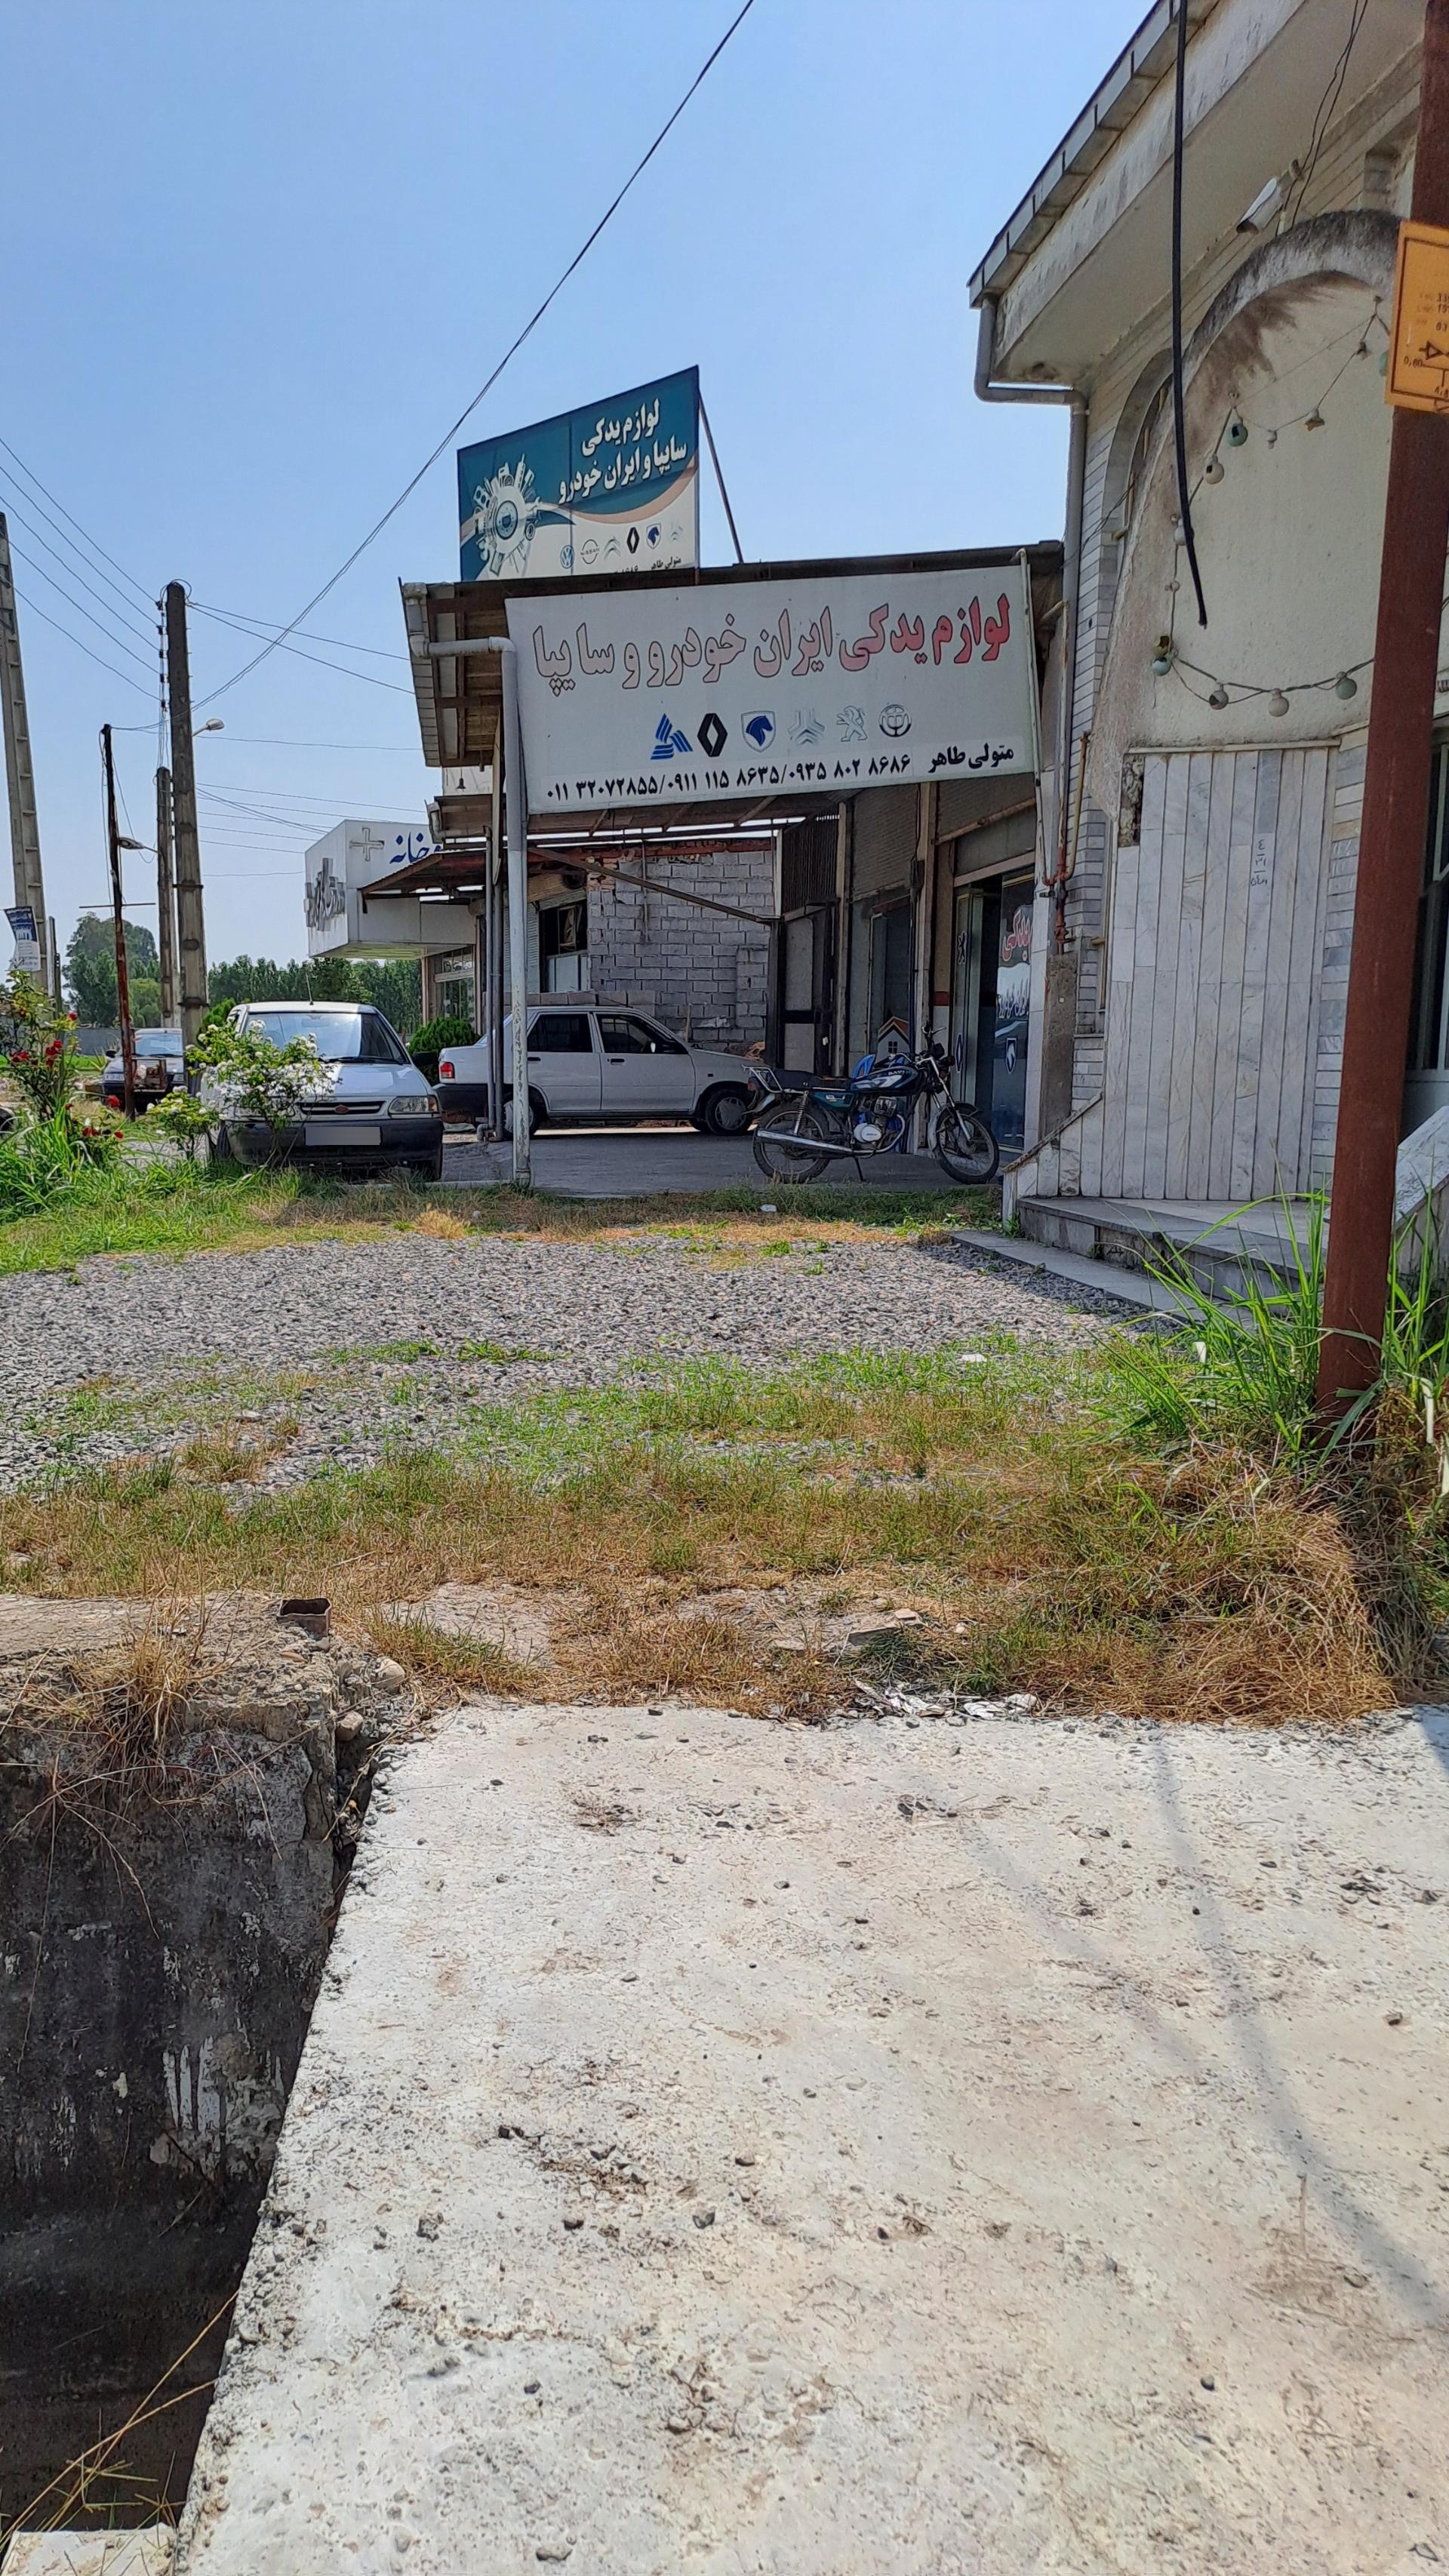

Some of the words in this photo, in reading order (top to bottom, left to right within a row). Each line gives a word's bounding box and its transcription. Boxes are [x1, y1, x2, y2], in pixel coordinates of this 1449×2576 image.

[582, 417, 621, 457] یدکی
[622, 398, 660, 445] لوازم
[604, 446, 641, 491] ایران
[641, 454, 651, 480] و
[653, 434, 688, 477] سایپا
[558, 459, 602, 505] خودرو
[646, 613, 747, 688] خودرو
[754, 605, 833, 678] ایران
[839, 602, 928, 672] یدکی
[931, 592, 1011, 666] لوازم
[532, 621, 616, 697] سایپا
[621, 642, 641, 690] و
[832, 759, 860, 780] ۸۰۲
[868, 752, 912, 775] ۸۶۸۶
[928, 746, 967, 774] طاهر
[968, 742, 1015, 770] متولی
[546, 782, 568, 801] ۰۱۱
[704, 769, 730, 789] ۱۱۵
